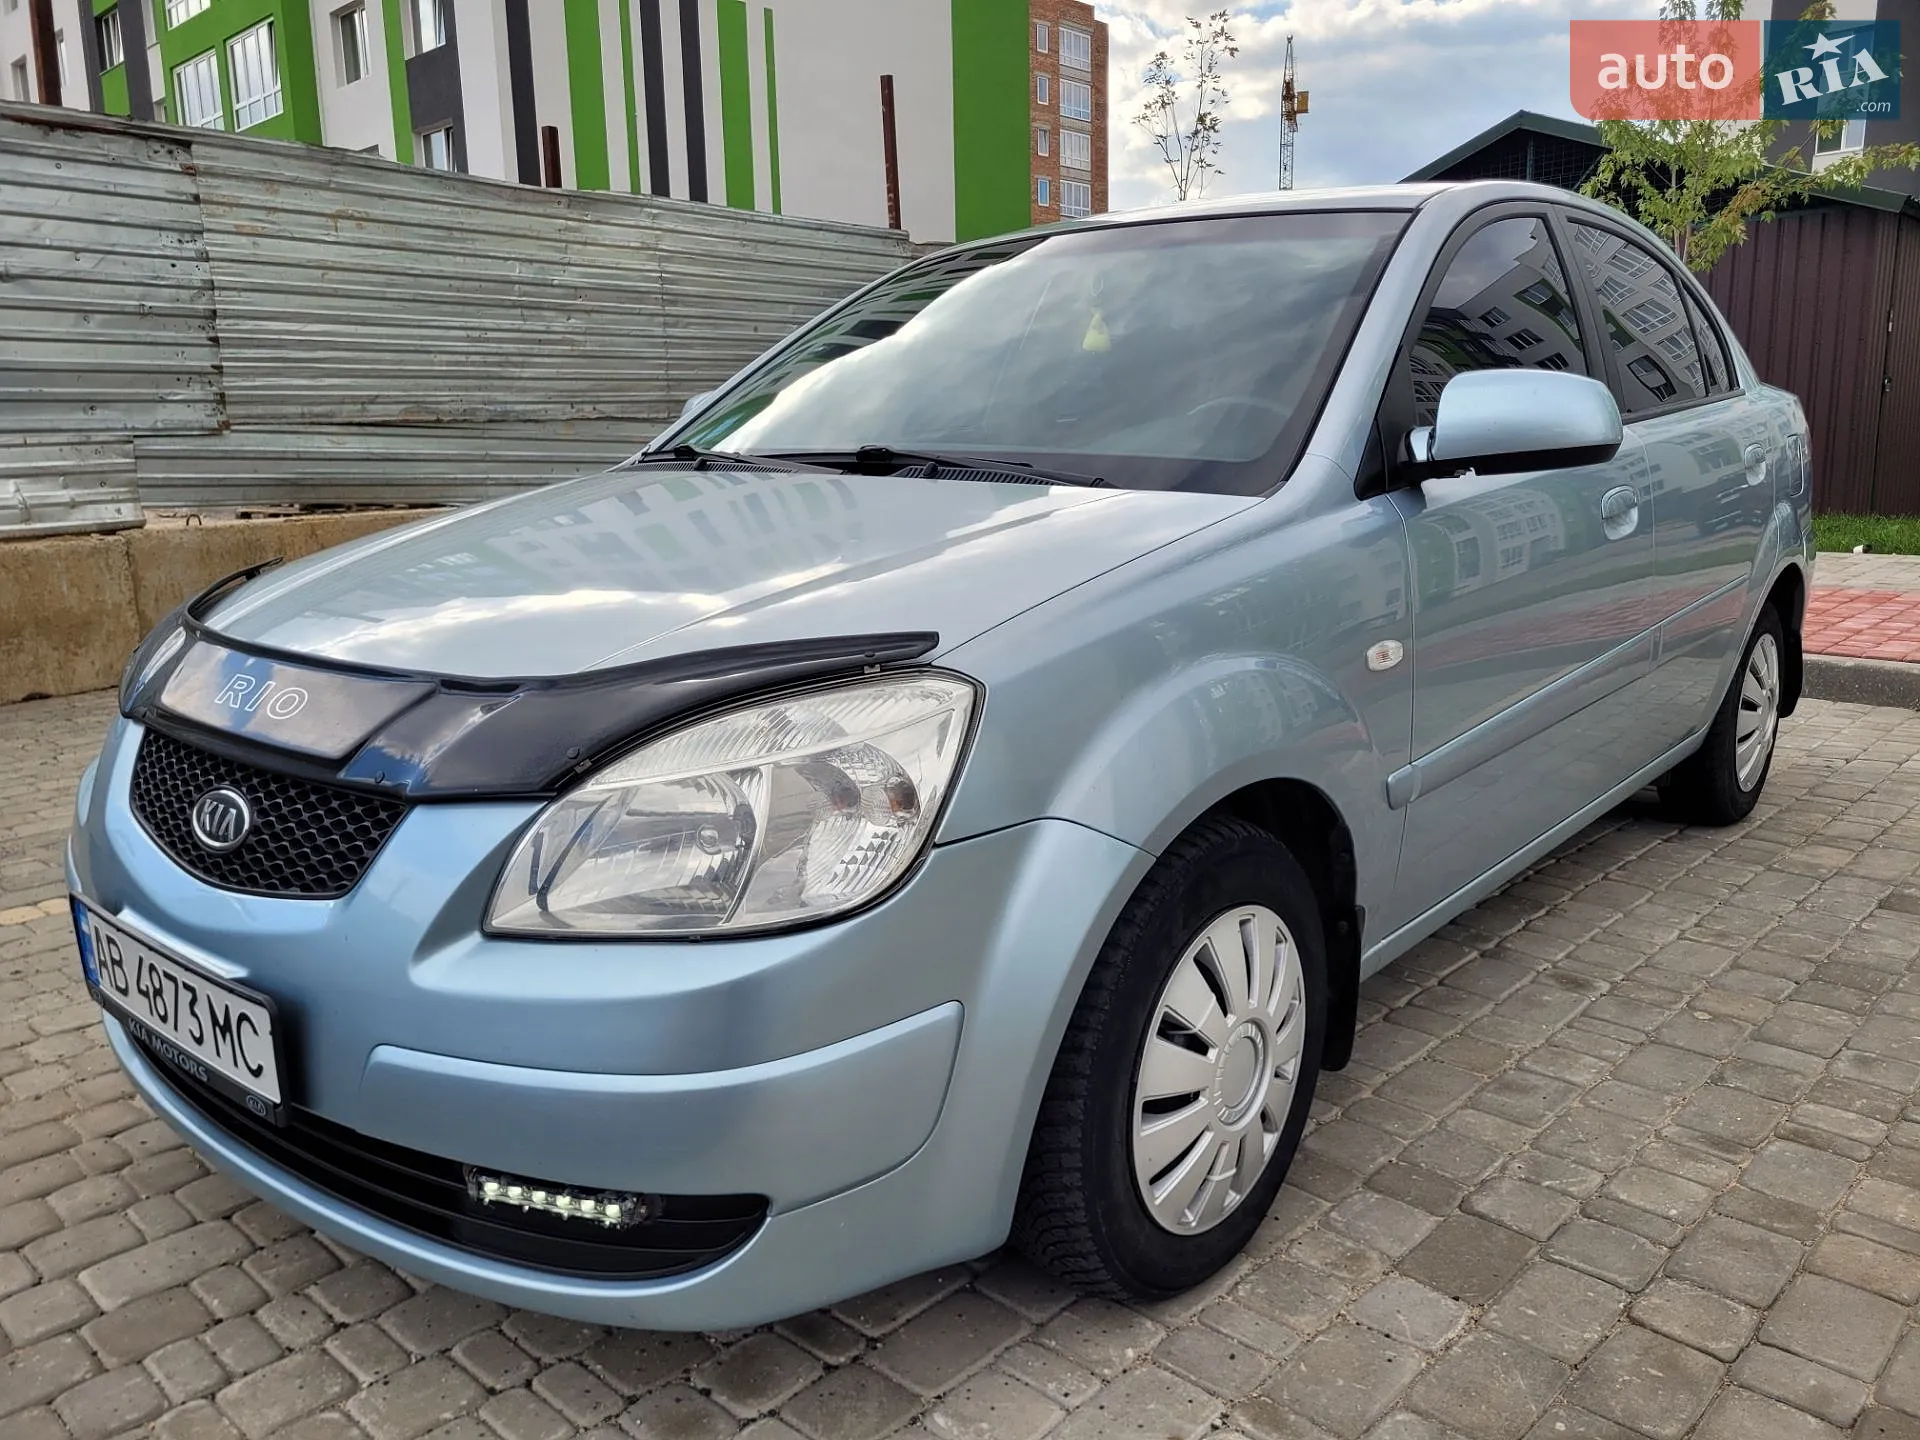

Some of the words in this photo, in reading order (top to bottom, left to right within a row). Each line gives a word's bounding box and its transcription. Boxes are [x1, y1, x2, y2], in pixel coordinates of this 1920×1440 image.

[214, 673, 308, 720] RIO
[200, 798, 237, 841] KIA
[94, 924, 130, 998] AB
[136, 955, 205, 1047] 4873
[206, 993, 264, 1079] MC
[128, 1017, 149, 1043] KIA
[151, 1035, 208, 1082] MOTORS
